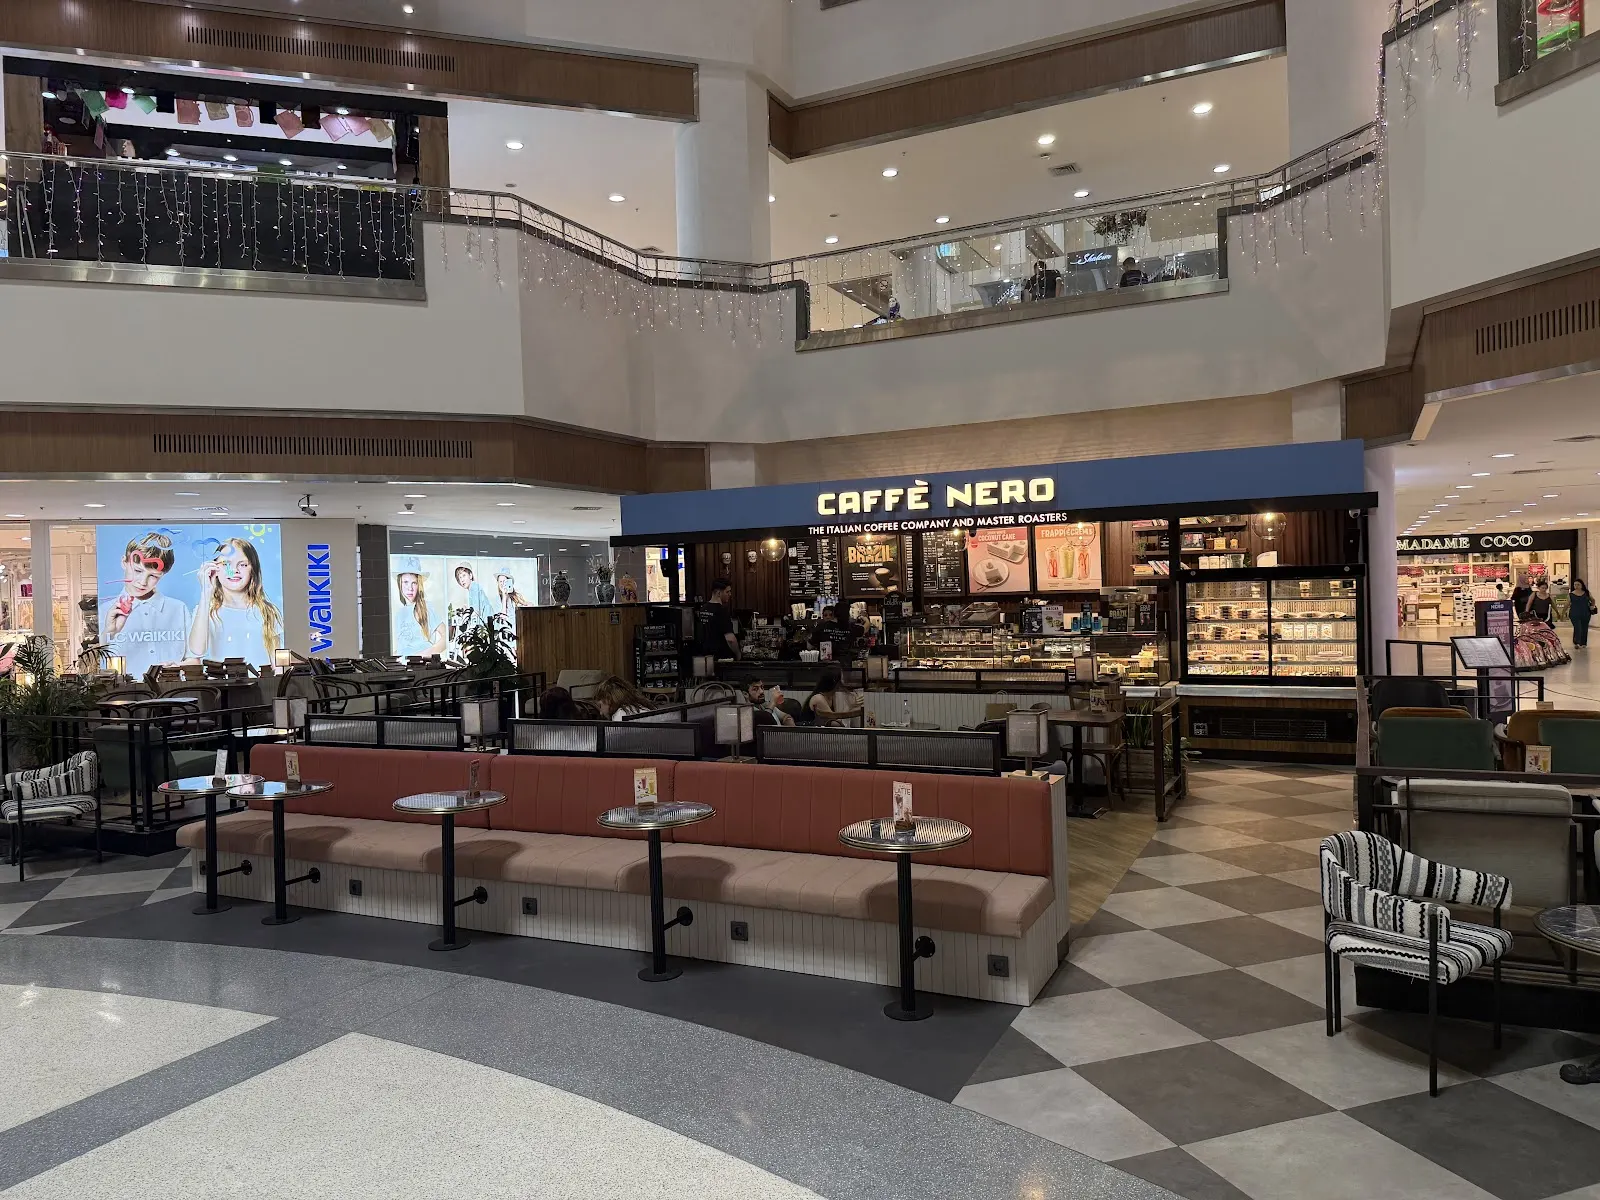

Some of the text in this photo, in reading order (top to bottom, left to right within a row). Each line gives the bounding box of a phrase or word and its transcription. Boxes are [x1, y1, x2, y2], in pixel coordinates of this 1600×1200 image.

[817, 477, 1055, 516] CAFFÈ NERO
[808, 512, 1068, 536] THE ITALIAN COFFEE COMPANY AND MASTER ROASTERS
[1396, 534, 1533, 551] MADAME COCO
[848, 544, 894, 564] BRAZIL
[106, 632, 127, 643] LC
[1488, 626, 1509, 635] COCONUT
